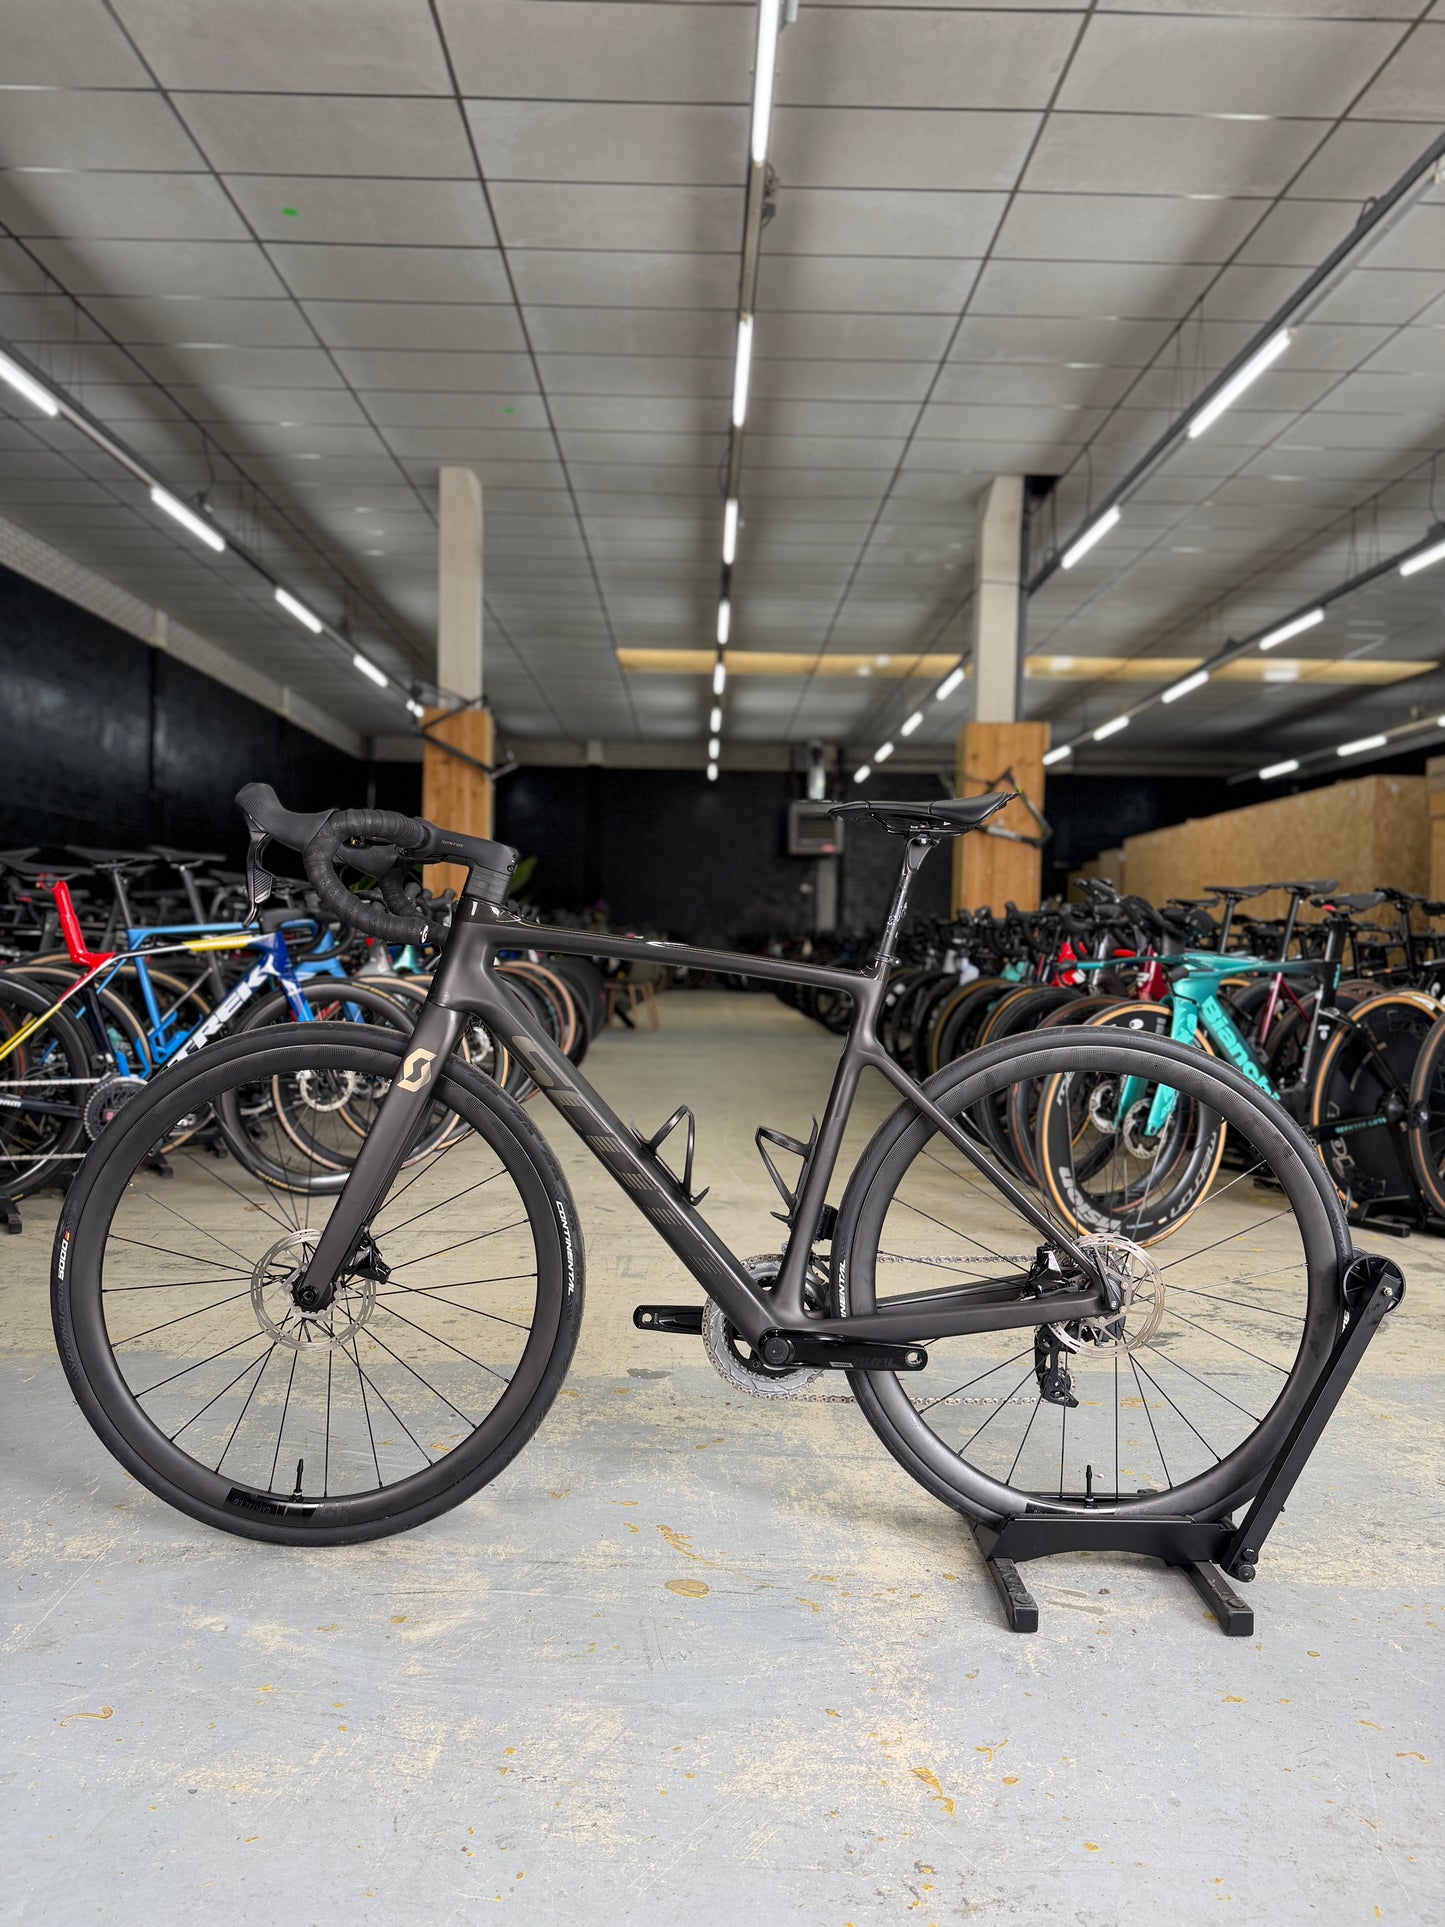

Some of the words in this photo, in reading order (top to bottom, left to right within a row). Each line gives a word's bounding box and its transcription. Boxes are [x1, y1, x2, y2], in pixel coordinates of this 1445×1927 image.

[166, 965, 268, 1067] TREK
[511, 1035, 741, 1290] SCOTT
[57, 1239, 70, 1281] 5000
[555, 1200, 575, 1296] CONTINENTAL
